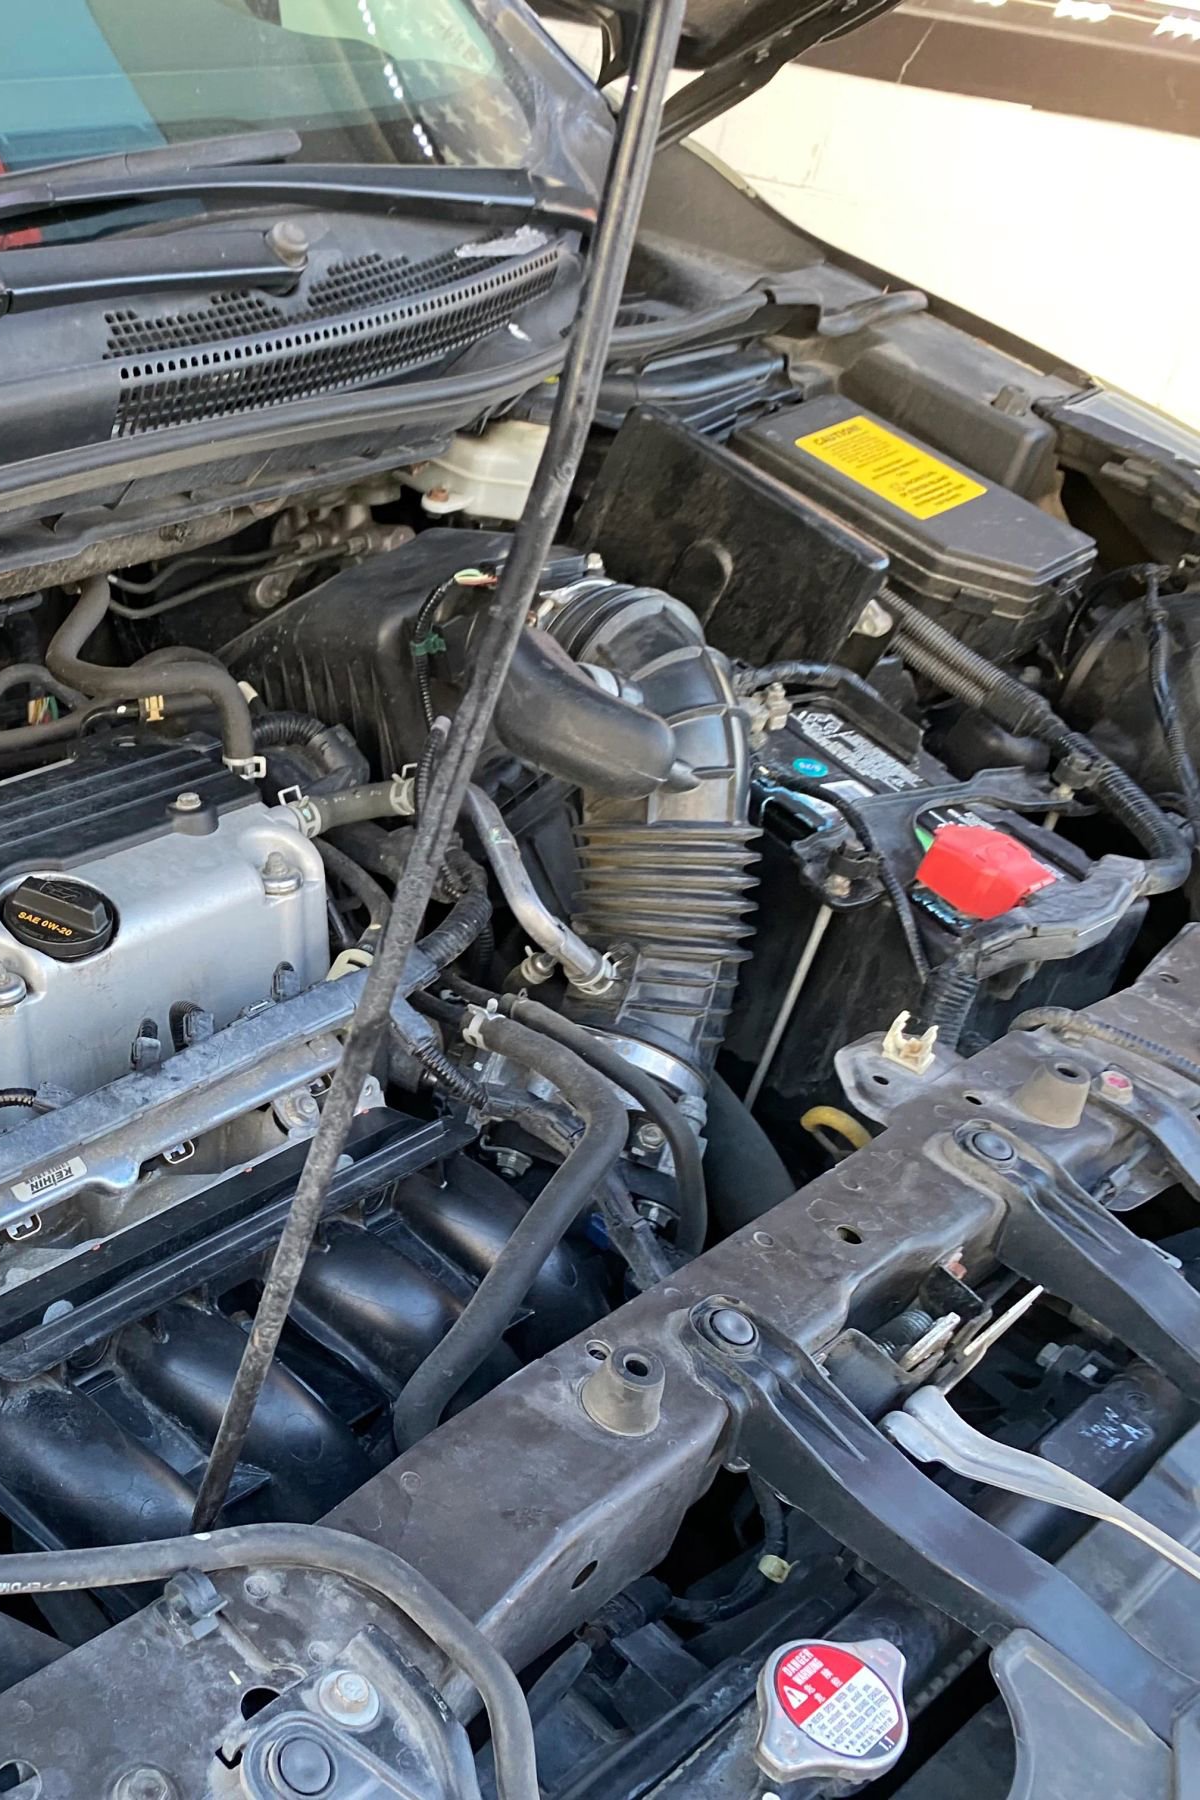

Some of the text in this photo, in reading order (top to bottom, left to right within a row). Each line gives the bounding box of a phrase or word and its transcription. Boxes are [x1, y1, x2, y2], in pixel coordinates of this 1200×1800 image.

[18, 911, 73, 936] SAE 0W-20
[30, 1166, 74, 1195] KEIHIN
[781, 1648, 815, 1677] DANGER
[791, 1657, 825, 1686] WARNING
[878, 1735, 895, 1751] 1.1
